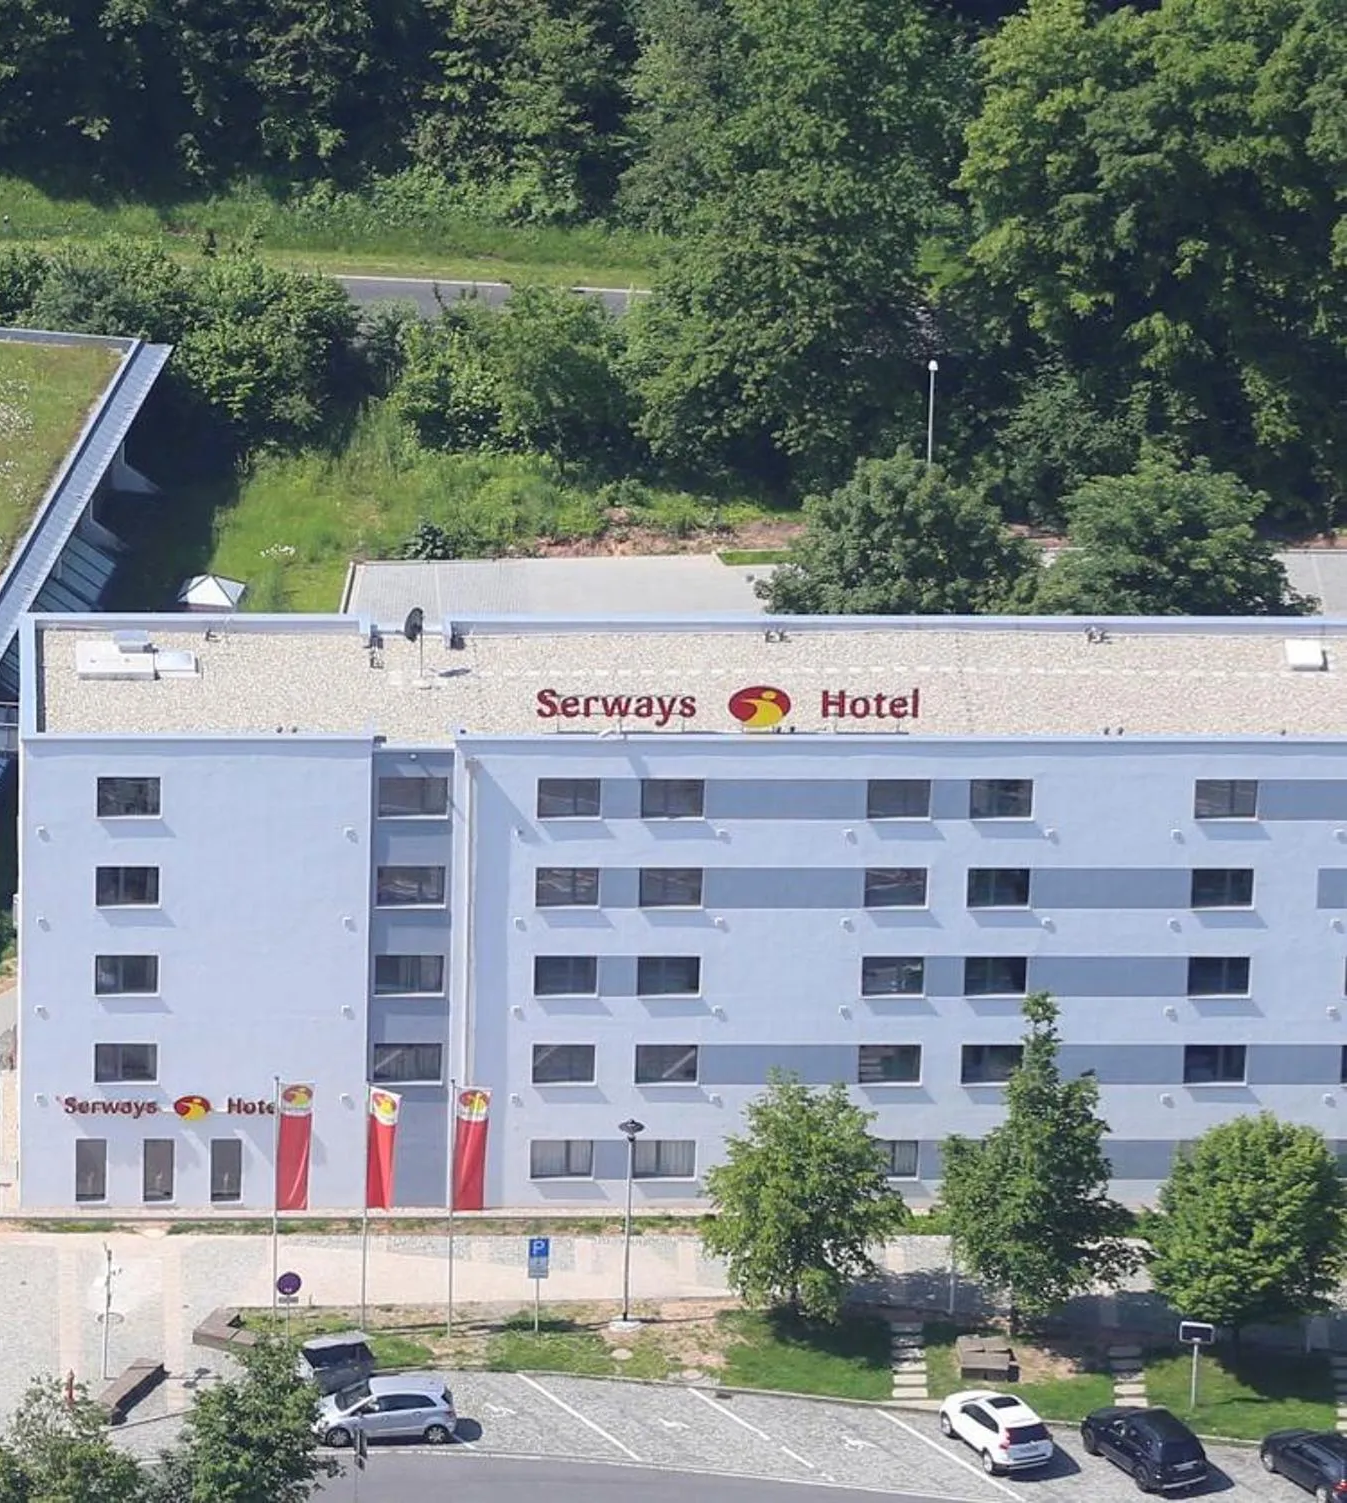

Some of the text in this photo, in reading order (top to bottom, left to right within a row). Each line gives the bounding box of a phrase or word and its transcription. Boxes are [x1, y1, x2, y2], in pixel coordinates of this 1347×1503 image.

[536, 688, 920, 726] Serways Hotel
[63, 1096, 276, 1120] Serways Hote
